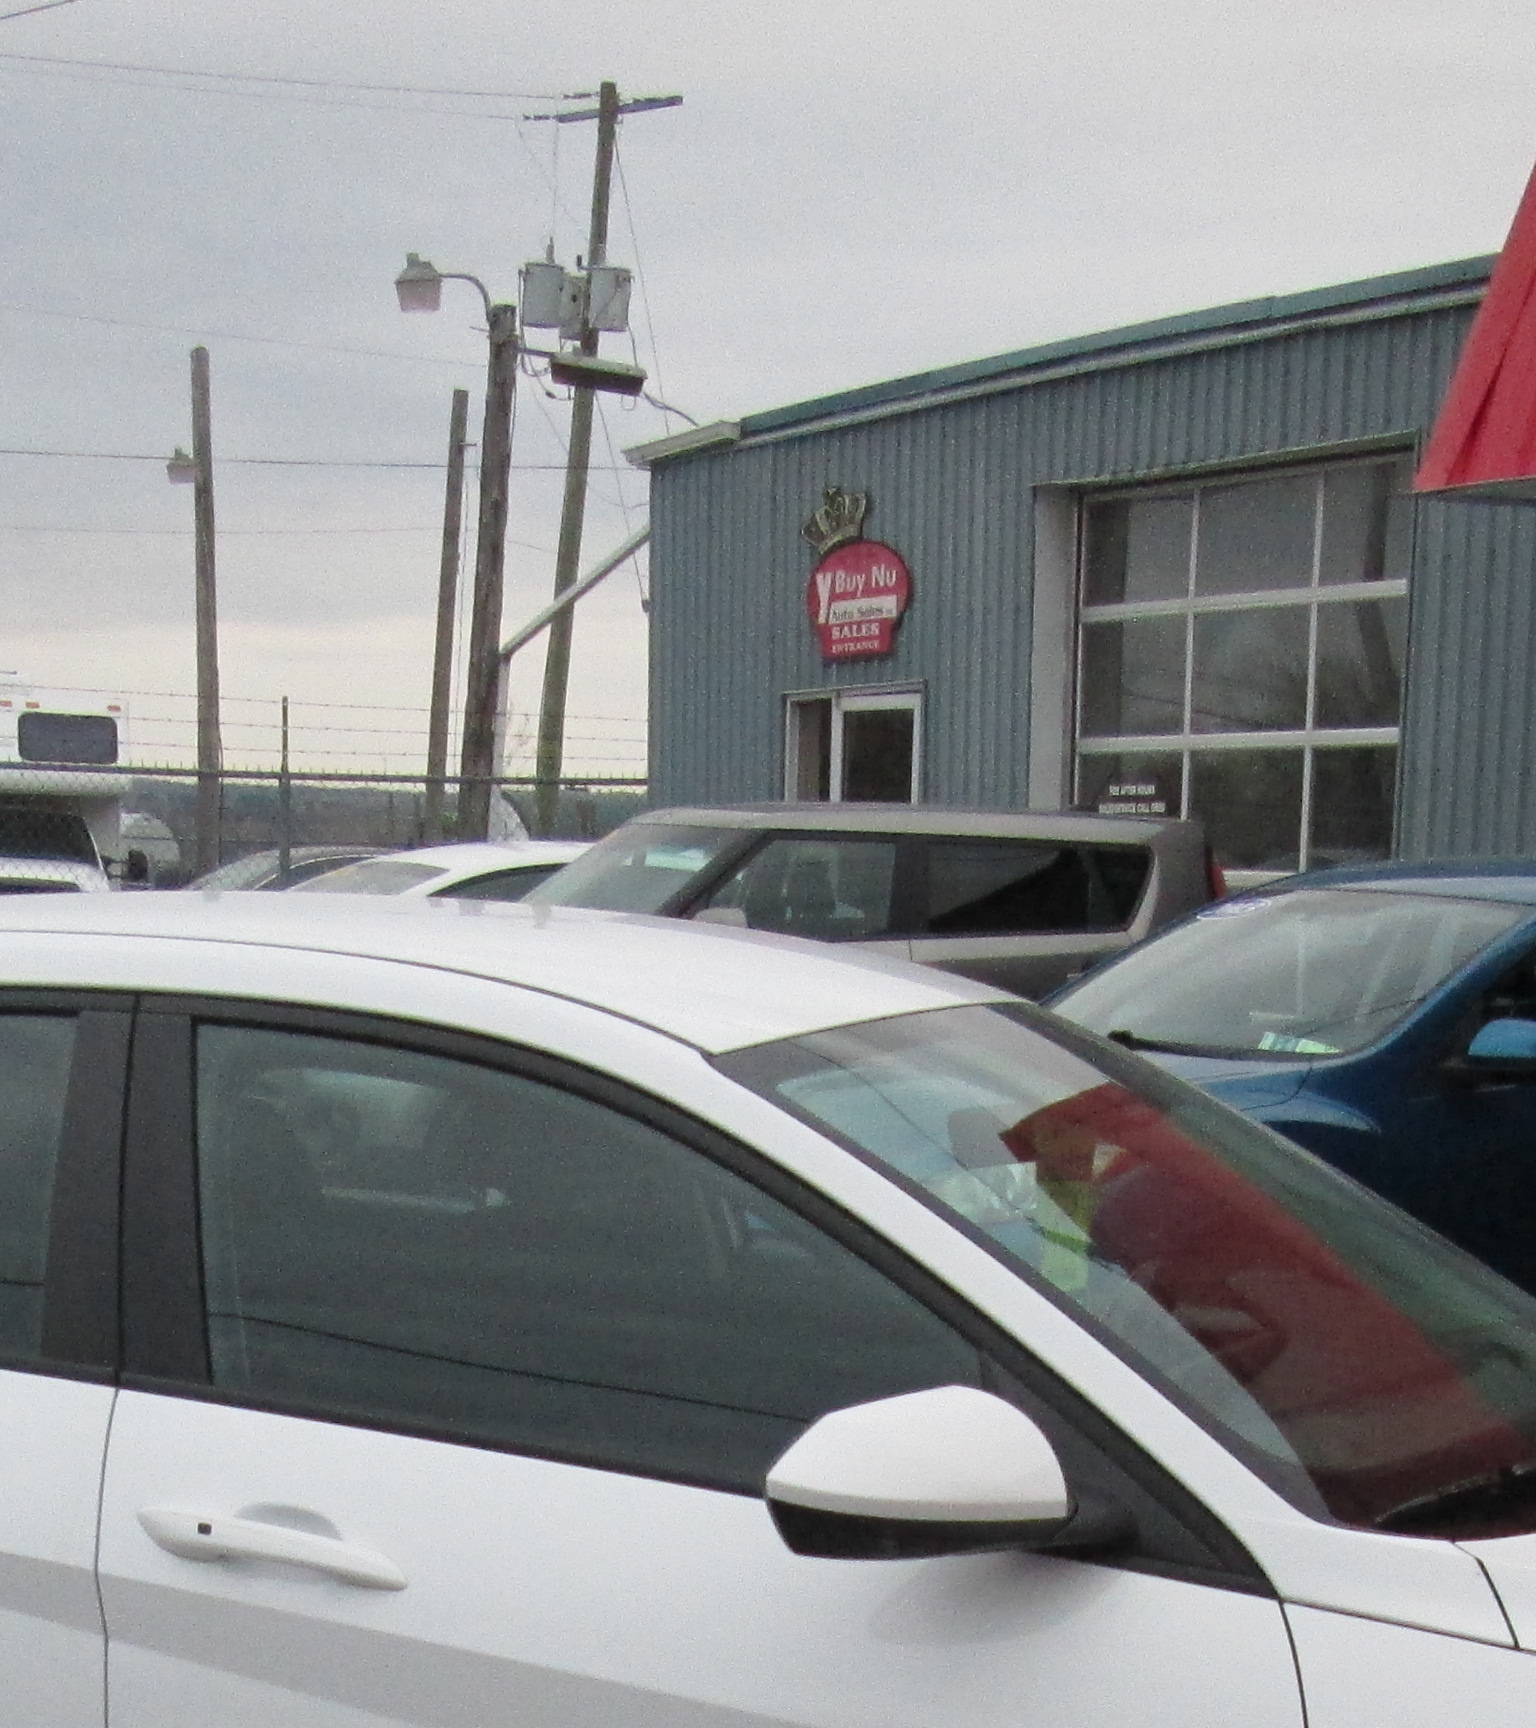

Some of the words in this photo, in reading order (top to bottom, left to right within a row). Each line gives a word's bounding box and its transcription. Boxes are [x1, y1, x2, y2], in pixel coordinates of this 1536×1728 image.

[834, 569, 865, 597] Buy
[871, 563, 897, 589] Nu
[831, 622, 880, 640] SALES
[832, 641, 880, 653] ENTRANCE
